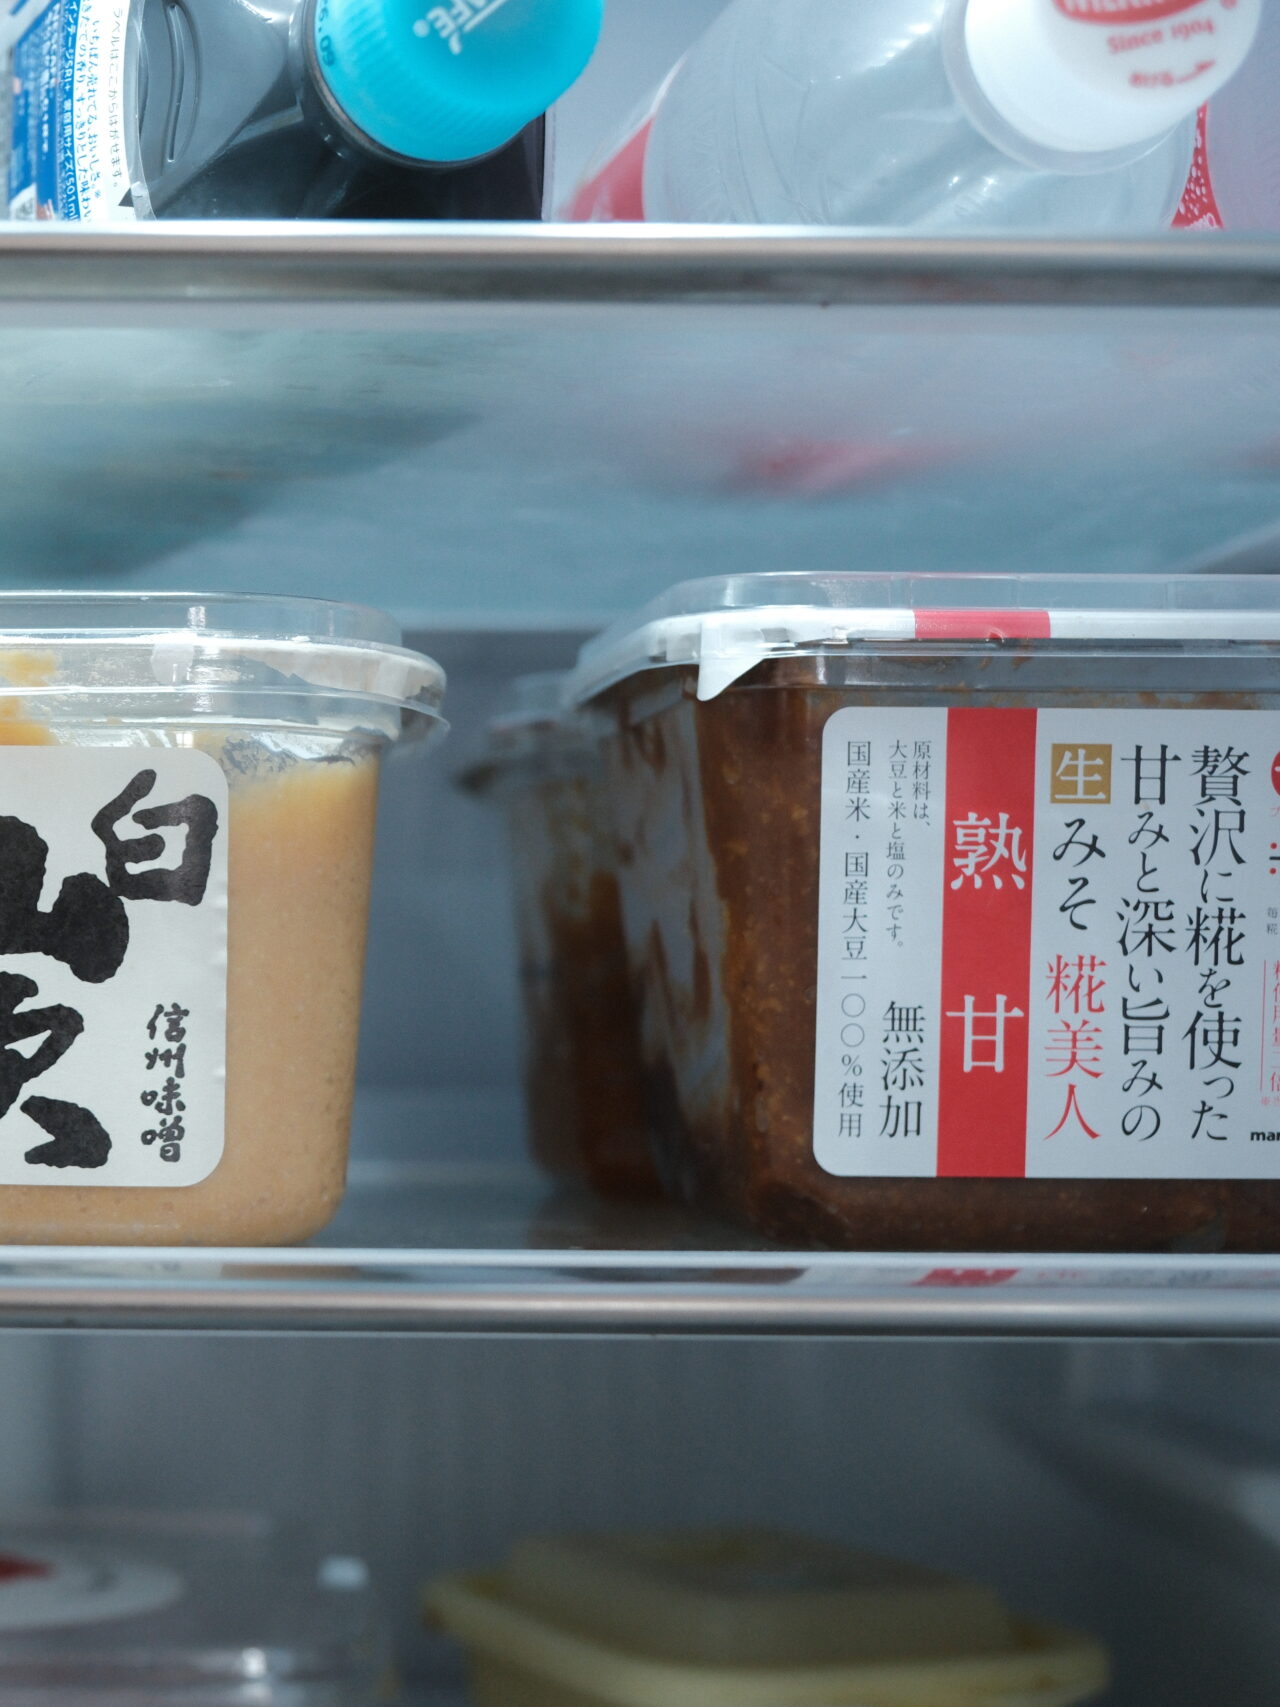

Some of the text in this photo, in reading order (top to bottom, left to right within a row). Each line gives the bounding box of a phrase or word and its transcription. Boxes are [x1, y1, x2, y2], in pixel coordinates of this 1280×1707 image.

[75, 0, 92, 222] きたての香り、すっきりとした味わい
[1107, 30, 1164, 54] Since
[885, 739, 908, 949] 大豆と米と塩のみです。
[912, 740, 933, 827] 原材料は、
[1116, 744, 1182, 1142] 甘みと深い旨みの
[1181, 744, 1252, 1142] 贅沢に糀を使った
[140, 1003, 190, 1163] 信州味噌
[879, 1000, 926, 1138] 無添加
[1043, 954, 1107, 1141] 糀美人
